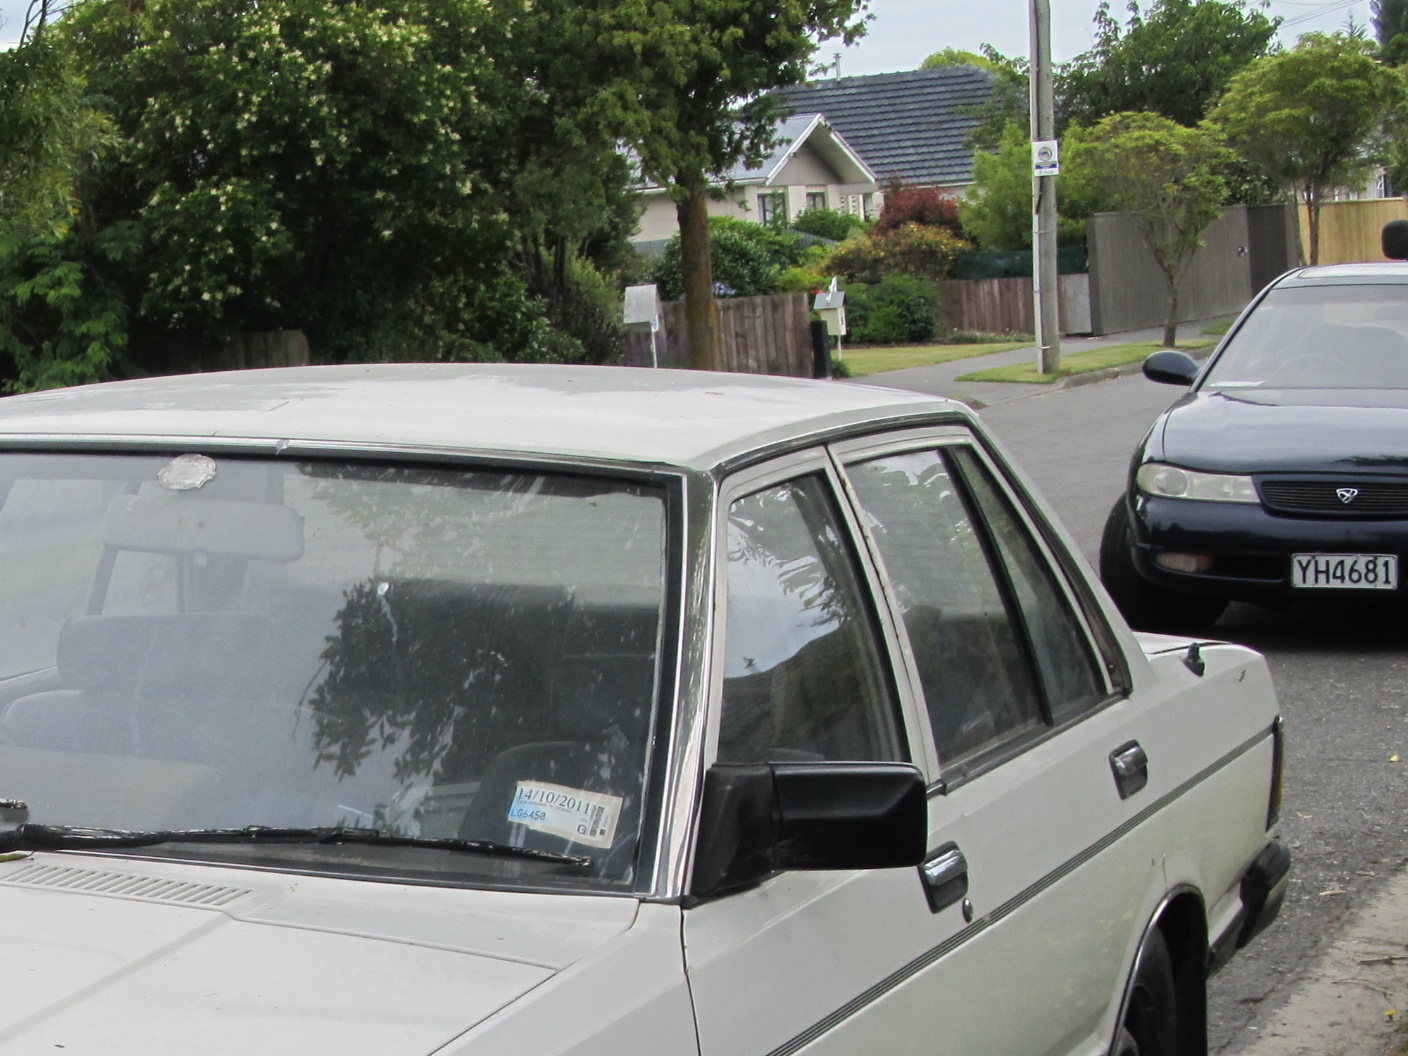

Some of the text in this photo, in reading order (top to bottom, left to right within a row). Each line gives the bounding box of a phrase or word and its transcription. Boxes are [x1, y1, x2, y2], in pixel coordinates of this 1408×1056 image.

[1297, 559, 1391, 585] YH4681
[517, 788, 591, 815] 14/10/2011
[510, 808, 547, 821] LG6450
[577, 824, 588, 835] G
